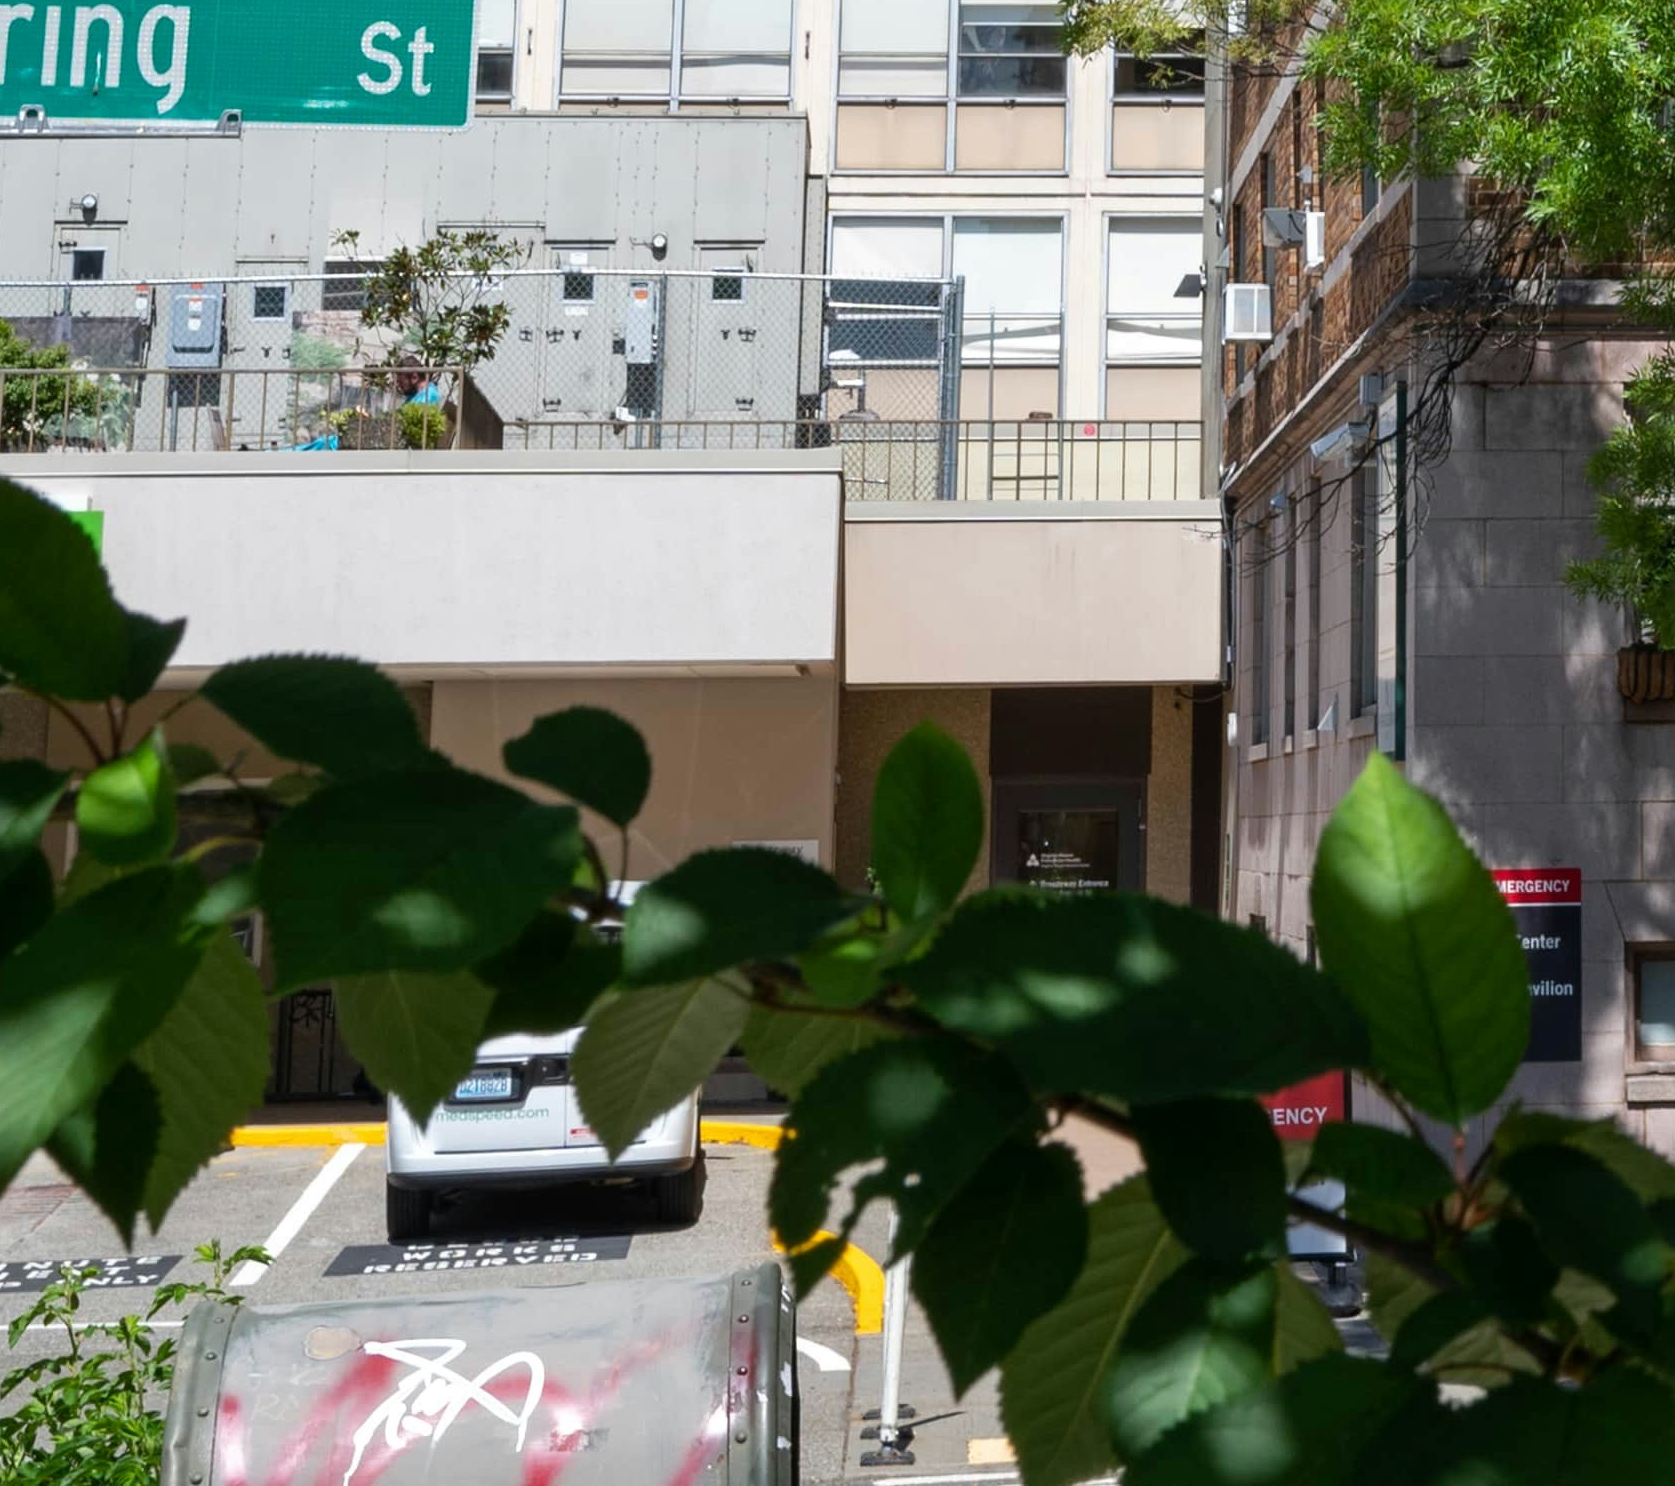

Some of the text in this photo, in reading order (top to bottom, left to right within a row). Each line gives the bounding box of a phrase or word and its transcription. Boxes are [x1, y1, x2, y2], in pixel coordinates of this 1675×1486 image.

[356, 20, 434, 97] St
[1494, 879, 1570, 894] MERGENCY
[1518, 934, 1561, 950] enter
[1528, 980, 1574, 997] vilion
[435, 1107, 549, 1124] medspeed.com
[1270, 1107, 1327, 1126] ENCY
[403, 1242, 575, 1261] WORKS
[363, 1252, 597, 1274] RESERVED
